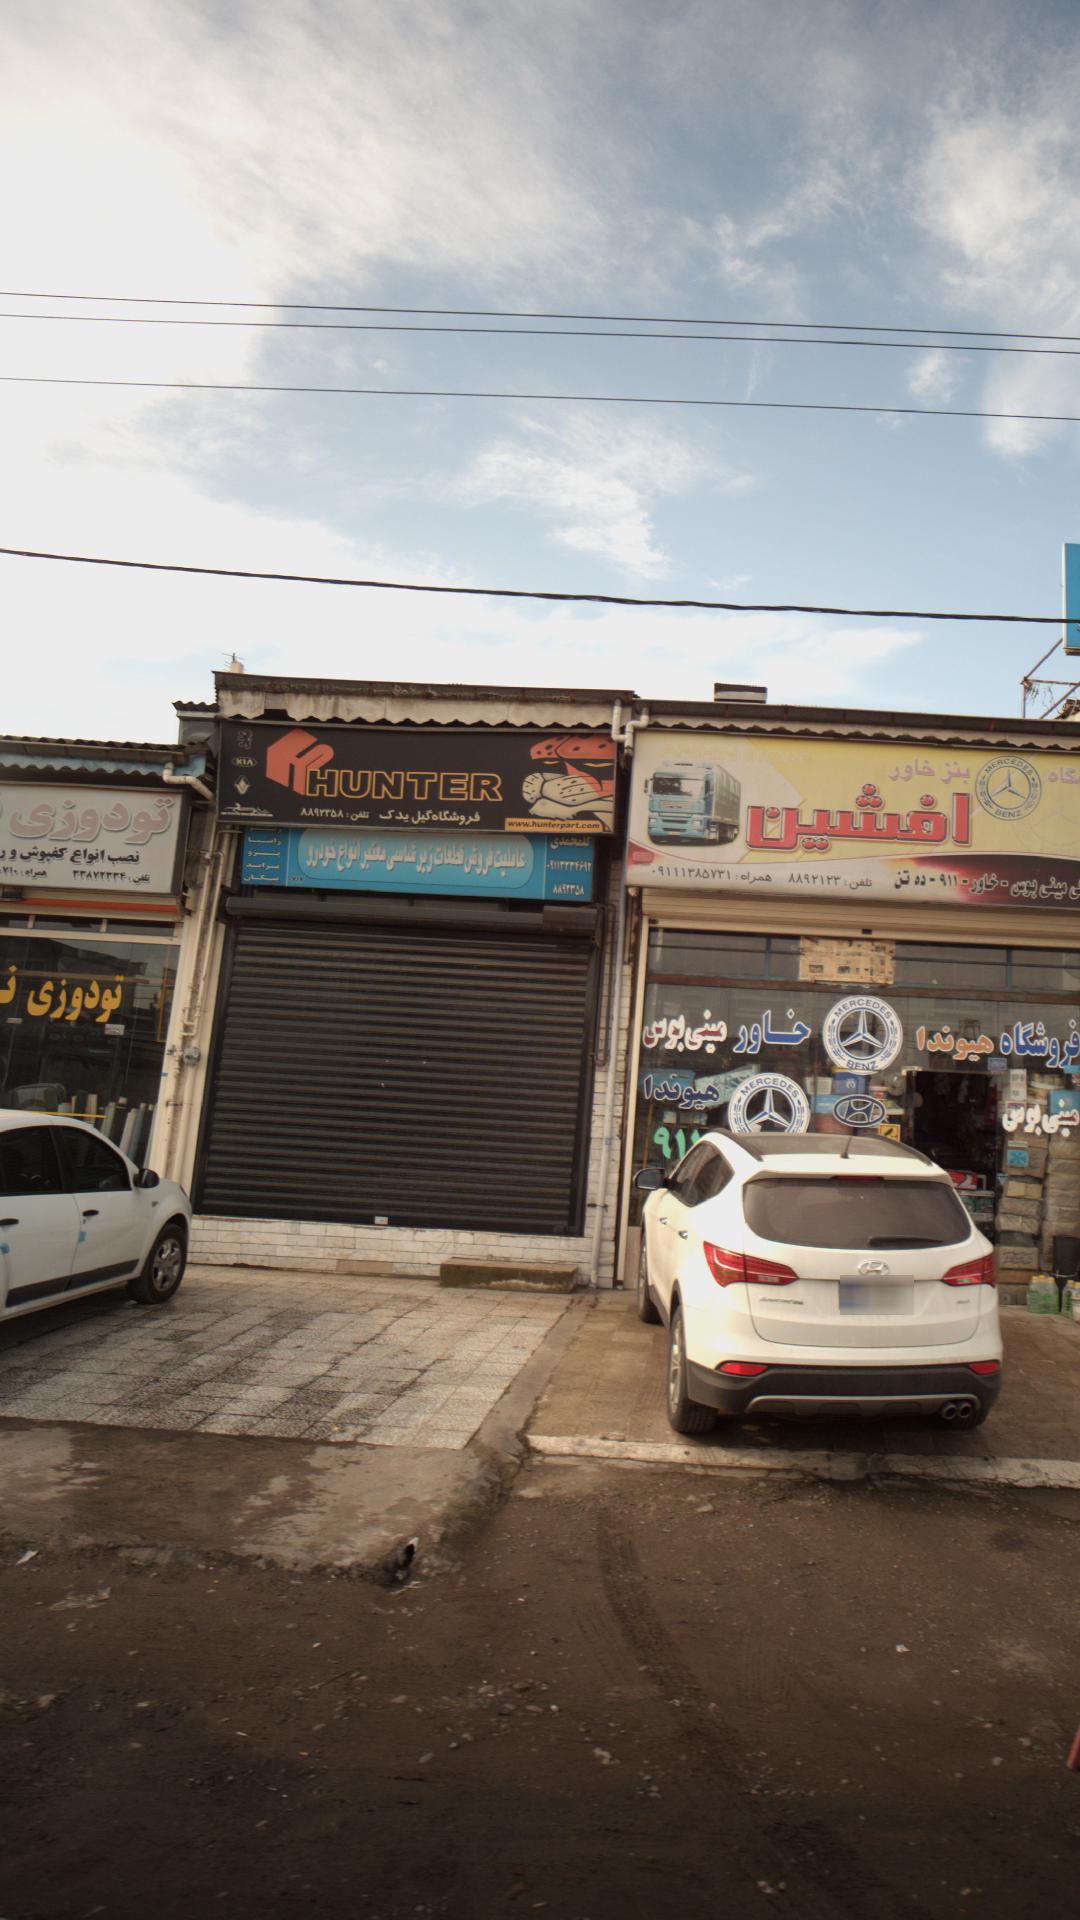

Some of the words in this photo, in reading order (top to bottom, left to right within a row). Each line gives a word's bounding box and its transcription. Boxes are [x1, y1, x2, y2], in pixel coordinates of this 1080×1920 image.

[888, 758, 935, 781] خاور
[940, 761, 970, 784] بنز
[985, 758, 1034, 777] MERCEDES
[304, 769, 503, 801] HUNTER
[10, 797, 174, 845] تودوزی
[300, 807, 345, 819] ۸۸۹۲۳۵۸
[379, 809, 409, 823] یدک
[411, 809, 432, 825] گیل
[432, 810, 481, 825] فروشگاه
[745, 783, 974, 853] افشین
[995, 808, 1023, 818] BENZ
[508, 820, 601, 831] www.hunterpart.com
[10, 849, 17, 861] و
[70, 849, 105, 865] انواع
[107, 850, 140, 867] نصب
[894, 870, 910, 890] تن
[914, 874, 926, 886] ده
[940, 873, 958, 888] ۹۱۱
[970, 873, 998, 896] خاور
[26, 975, 125, 1023] تودوزی
[835, 998, 892, 1019] MERCEDES
[733, 1008, 811, 1053] خاور
[916, 1026, 995, 1061] هیوندا
[1000, 1018, 1080, 1068] فروشگاه
[846, 1058, 879, 1071] BENZ
[643, 1074, 721, 1110] هیوندا
[740, 1077, 801, 1098] MERCEDES
